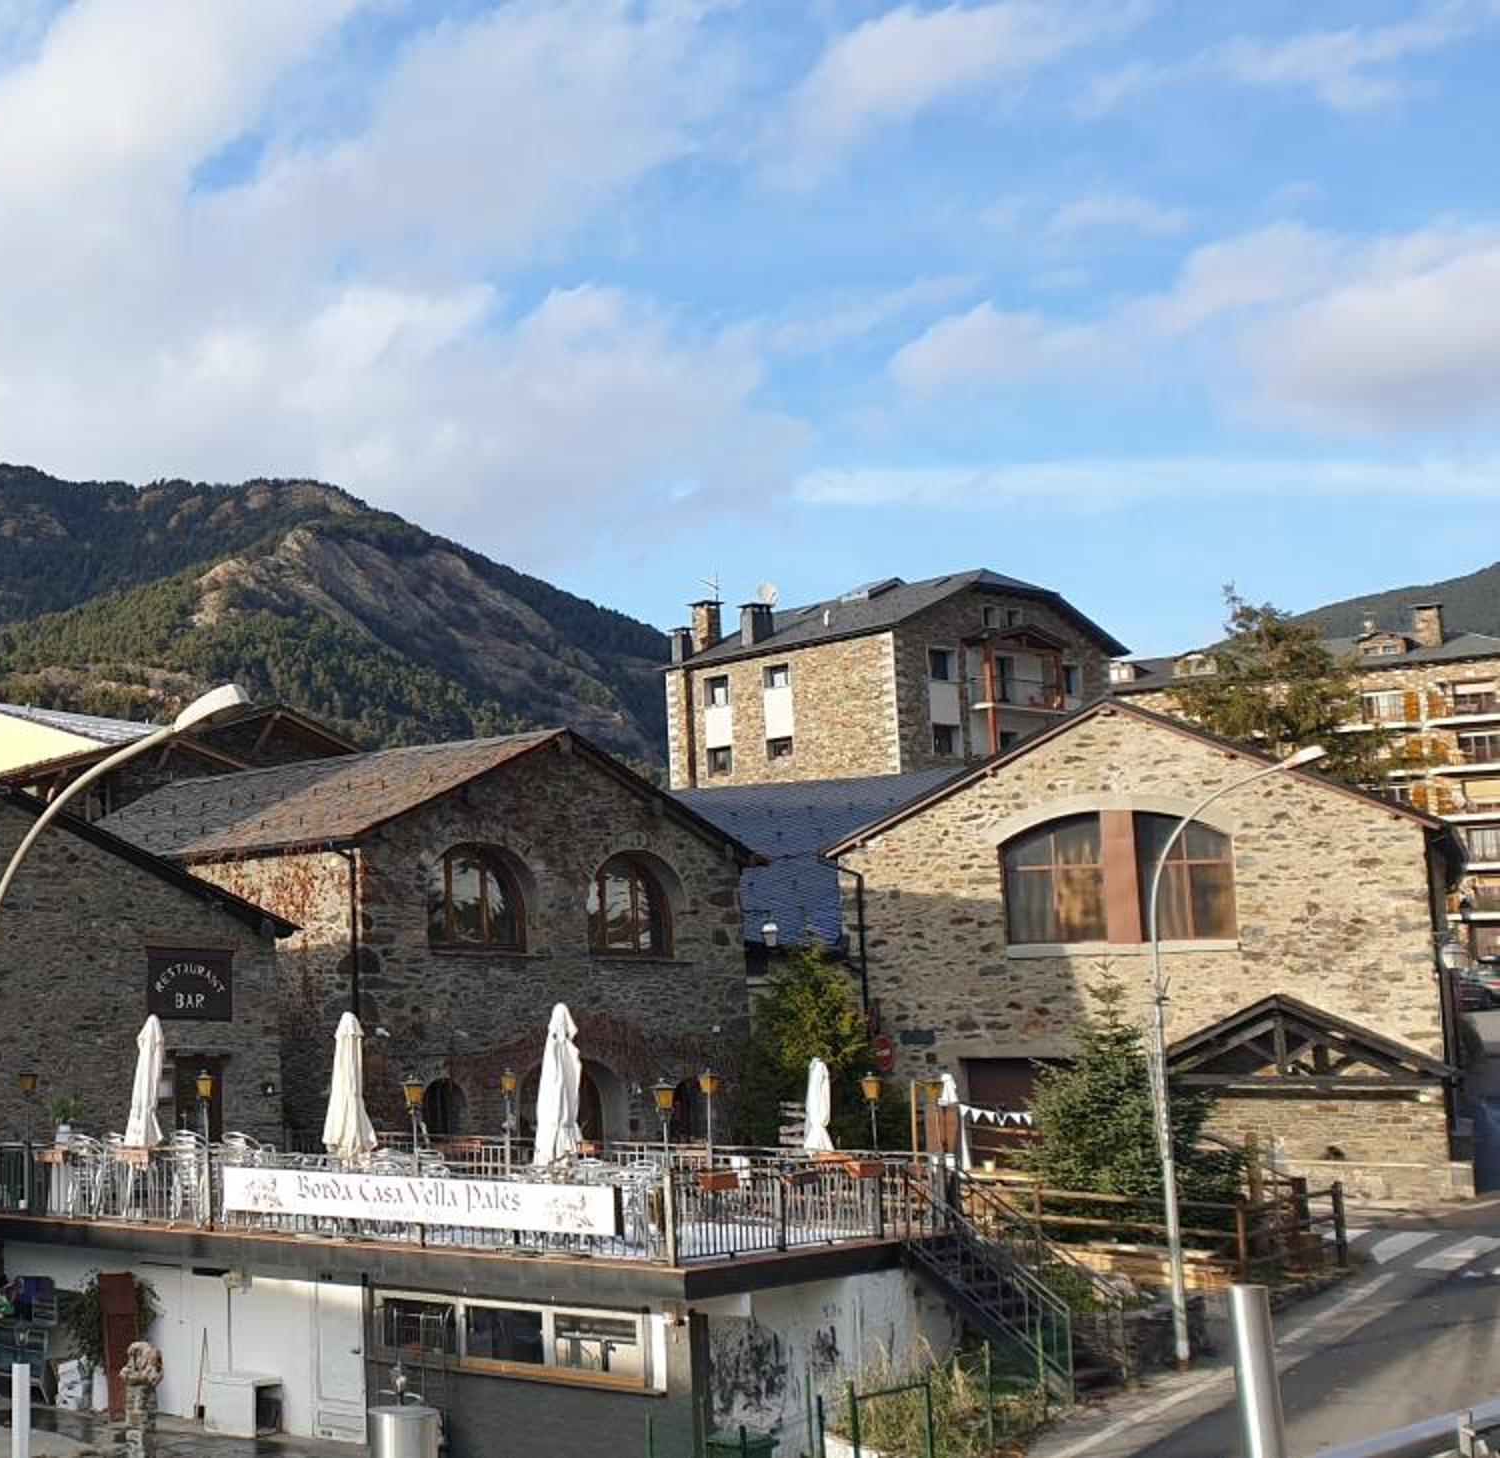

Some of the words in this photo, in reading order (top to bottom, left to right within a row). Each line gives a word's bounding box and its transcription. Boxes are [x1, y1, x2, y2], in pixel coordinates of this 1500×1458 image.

[155, 963, 226, 993] RESTAURANT
[175, 992, 205, 1009] BAR
[296, 1175, 352, 1202] Borda
[359, 1179, 404, 1204] Casa
[406, 1182, 459, 1208] Vella
